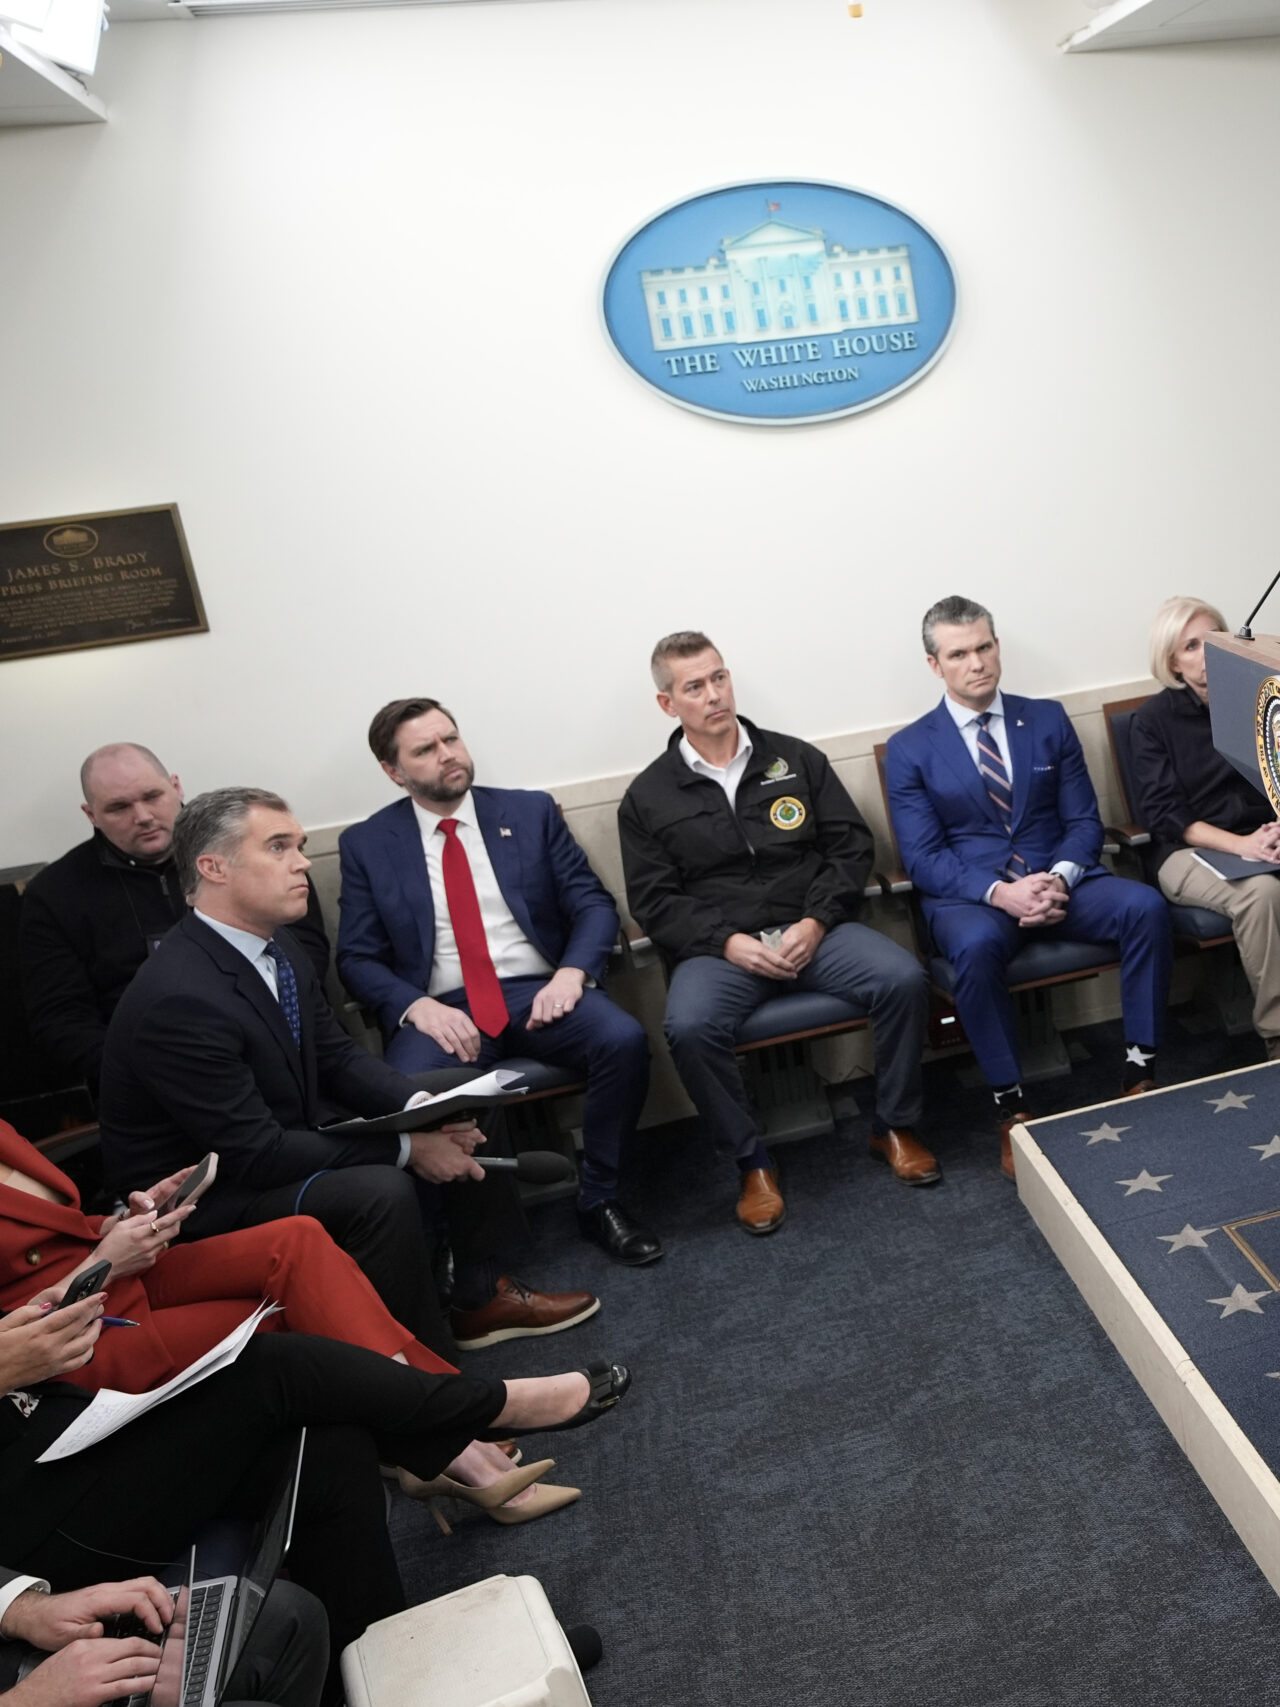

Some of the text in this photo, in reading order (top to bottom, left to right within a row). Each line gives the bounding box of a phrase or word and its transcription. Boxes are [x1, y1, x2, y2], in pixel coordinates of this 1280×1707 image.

[664, 331, 917, 377] THE WHITE HOUSE
[742, 367, 859, 392] WASHINGTON
[1, 567, 162, 597] PRESS BRIEFING ROOM
[7, 551, 147, 583] JAMES S. BRADY
